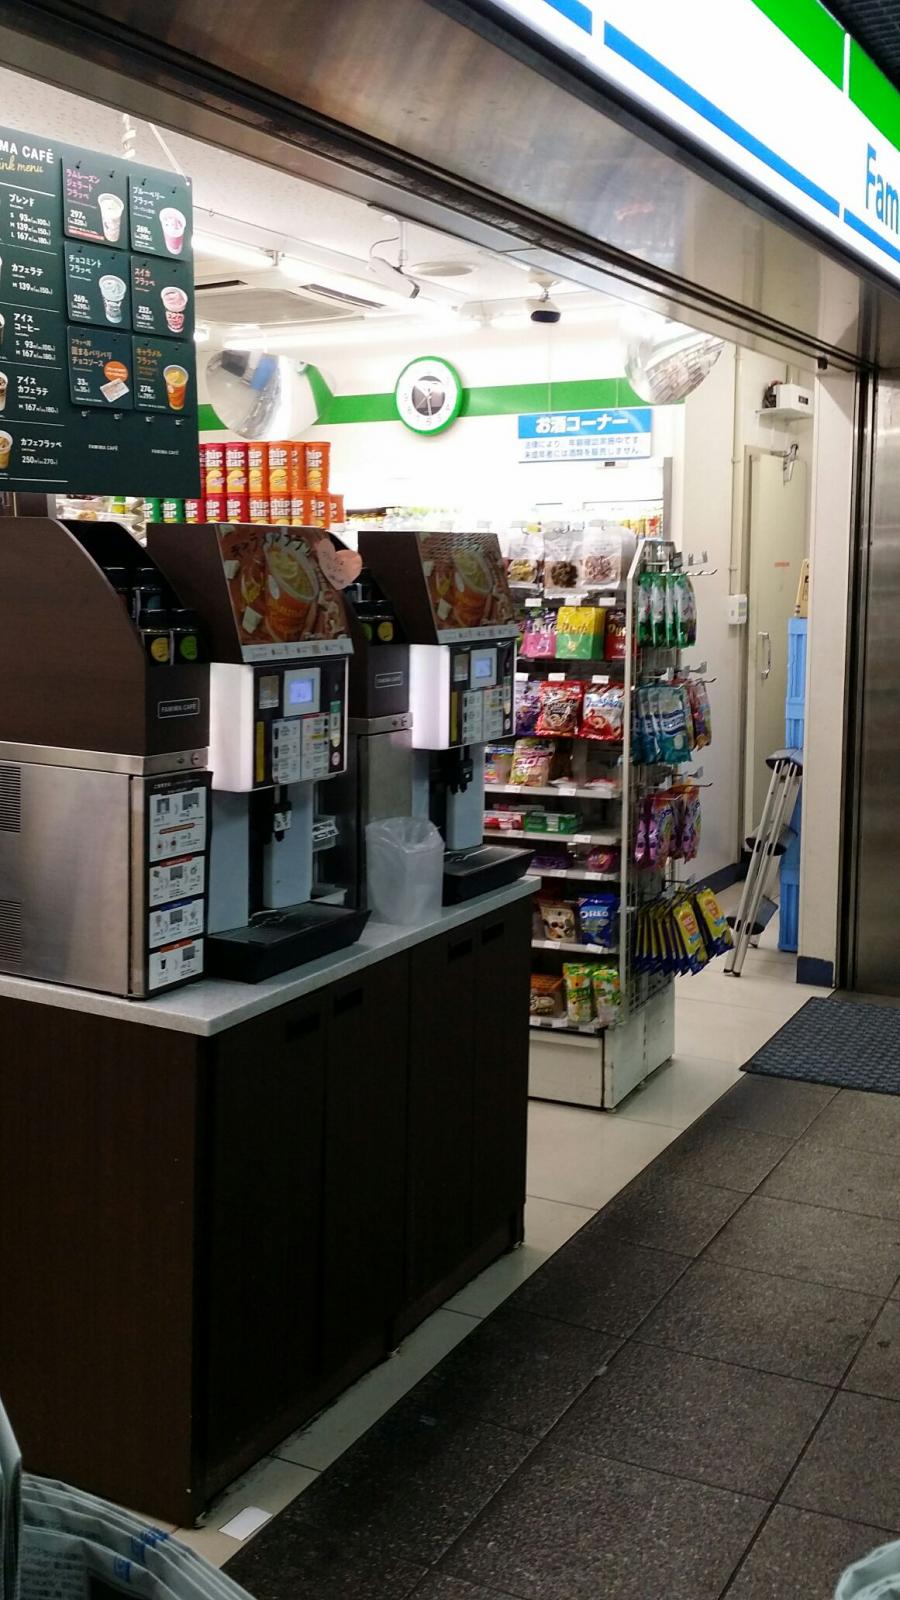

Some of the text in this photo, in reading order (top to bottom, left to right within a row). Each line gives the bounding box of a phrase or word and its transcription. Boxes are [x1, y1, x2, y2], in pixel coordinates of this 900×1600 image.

[22, 145, 54, 164] CAFÉ
[17, 162, 44, 173] menu
[66, 168, 100, 184] ラムレーズン
[67, 178, 93, 192] ジェラート
[866, 142, 900, 235] Fam
[67, 188, 89, 199] フラッペ
[132, 186, 166, 200] ブルーベリー
[9, 193, 35, 207] ブレンド
[133, 195, 154, 206] フラッペ
[69, 254, 102, 268] チョコミント
[11, 263, 44, 276] カフェラテ
[69, 264, 91, 274] フラッペ
[135, 277, 155, 287] フラッペ
[13, 313, 33, 323] アイス
[14, 323, 40, 332] コーヒー
[17, 376, 36, 385] アイス
[17, 386, 49, 396] カフェラテ
[535, 413, 629, 434] お酒コーナー
[20, 438, 62, 448] カフェフラッペ
[580, 911, 608, 919] OREO
